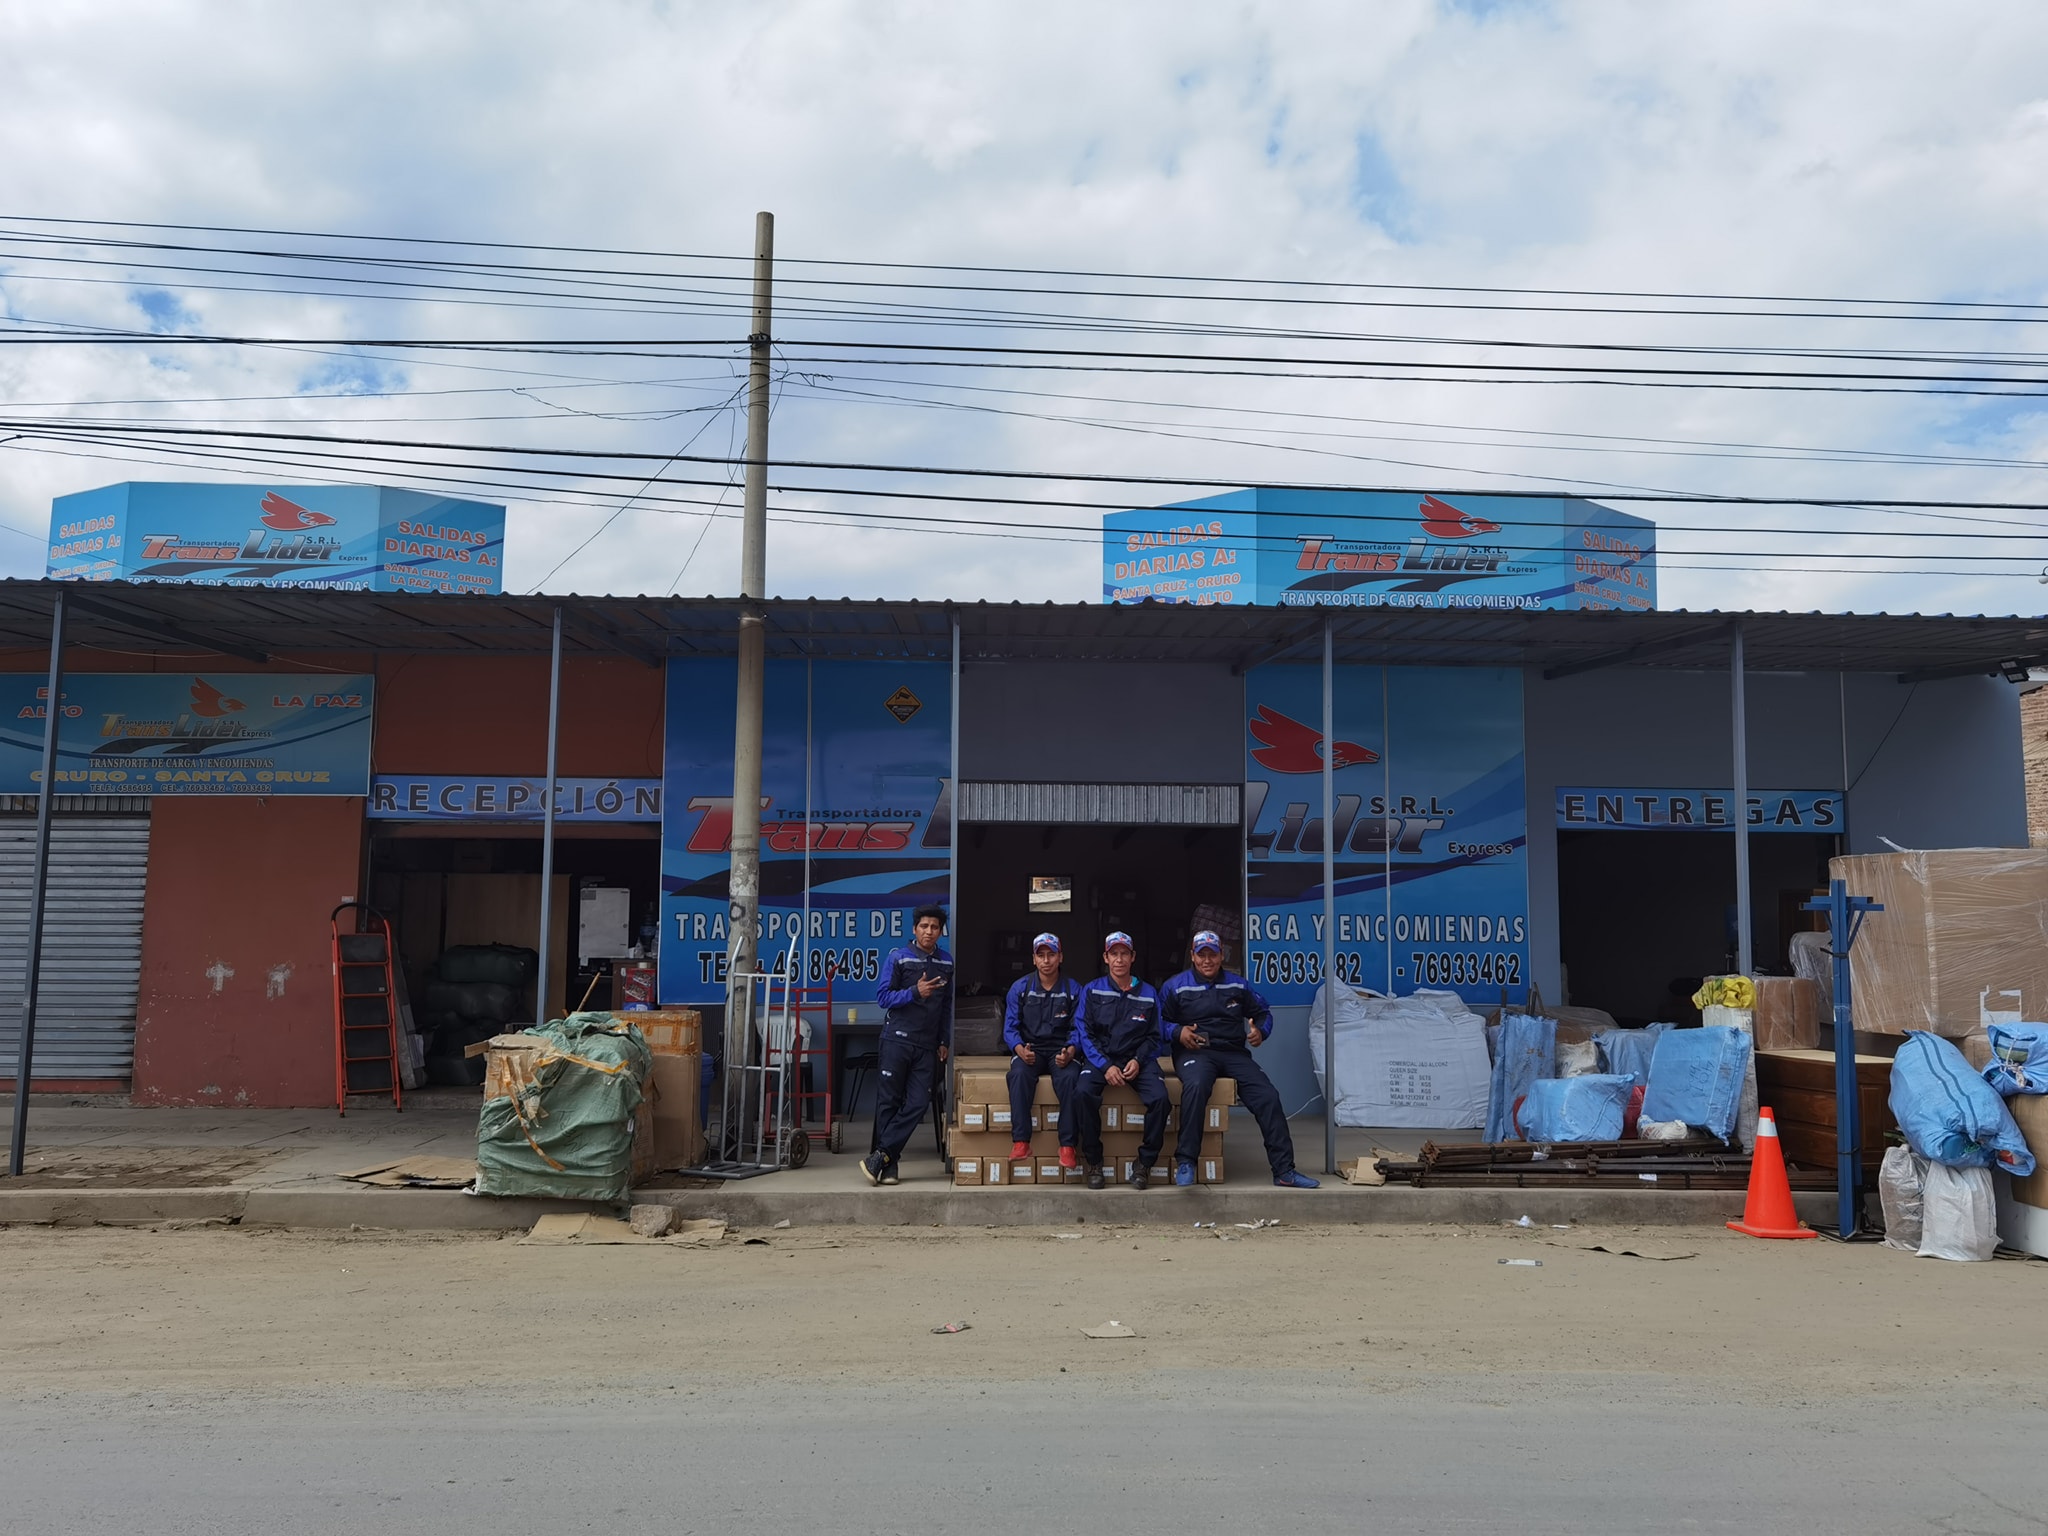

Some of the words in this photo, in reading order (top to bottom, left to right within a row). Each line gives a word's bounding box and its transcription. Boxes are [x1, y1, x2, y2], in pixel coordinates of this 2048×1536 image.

[60, 515, 115, 538] SALIDAS
[398, 520, 487, 545] SALIDAS
[1126, 521, 1223, 552] SALIDAS
[51, 537, 103, 559] DIARIAS
[106, 534, 121, 548] A:
[142, 534, 239, 560] Trans
[240, 529, 341, 561] Lider
[307, 536, 341, 545] S.R.L.
[385, 538, 471, 563] DIARIAS
[477, 552, 497, 567] A:
[1296, 534, 1400, 571] Trans
[1403, 537, 1508, 571] Lider
[1334, 543, 1401, 551] Transportadora
[1471, 546, 1508, 554] S.R.L.
[1583, 530, 1641, 562] SALIDAS
[384, 563, 418, 575] SANTA
[421, 569, 448, 579] CRUZ
[457, 574, 493, 585] ORURO
[1115, 551, 1205, 580] DIARIAS
[1212, 548, 1236, 567] A:
[1575, 554, 1632, 586] DIARIAS
[1635, 572, 1649, 590] A:
[390, 575, 405, 585] LA
[408, 578, 430, 588] PAZ
[440, 582, 453, 592] EL
[1113, 586, 1150, 600] SANTA
[1154, 581, 1187, 594] CRUZ
[1197, 573, 1241, 588] ORURO
[1574, 581, 1600, 597] SANTA
[1602, 588, 1622, 602] CRUZ
[1627, 595, 1652, 609] ORURO
[1196, 591, 1233, 605] ALTO
[1281, 592, 1364, 606] TRANSPORTE
[1387, 593, 1433, 607] CARGA
[1436, 595, 1445, 607] Y
[1449, 595, 1541, 609] ENCOMIENDAS
[272, 695, 305, 708] LA
[314, 695, 362, 708] PAZ
[101, 713, 172, 737] Trans
[172, 713, 246, 737] Lider
[241, 729, 272, 738] Express
[89, 758, 149, 768] TRANSPORTE
[151, 758, 163, 768] DE
[165, 758, 197, 768] CARGA
[199, 758, 206, 768] Y
[207, 758, 274, 768] ENCOMIENDAS
[117, 784, 152, 792] 4586495
[185, 784, 225, 792] 76933462
[232, 784, 271, 792] 76933482
[154, 770, 247, 782] SANTA
[256, 771, 330, 783] CRUZ
[373, 781, 661, 815] RECEPCIÓN
[1370, 796, 1454, 815] S.R.L.
[776, 807, 922, 820] Transportadora
[1563, 794, 1835, 827] ENTREGAS
[1448, 841, 1513, 856] Express
[870, 911, 903, 938] DE
[1311, 914, 1326, 940] Y
[1339, 914, 1524, 943] ENCOMIENDAS
[1412, 951, 1521, 985] 76933462
